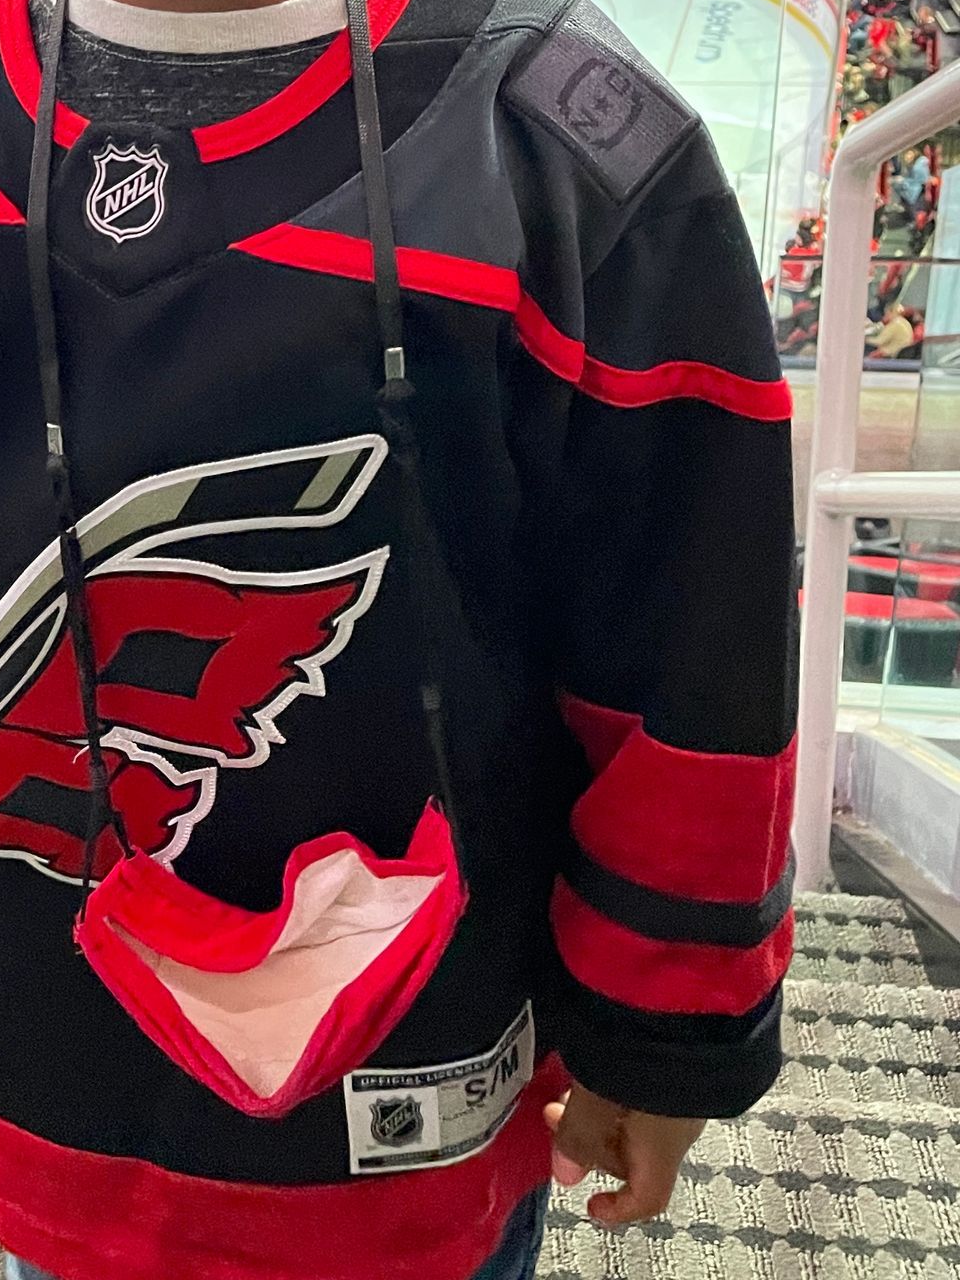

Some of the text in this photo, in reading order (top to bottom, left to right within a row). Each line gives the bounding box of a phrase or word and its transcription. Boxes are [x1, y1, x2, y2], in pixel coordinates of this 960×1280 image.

[103, 172, 154, 220] NHL
[359, 1073, 422, 1087] OFFICIAL
[464, 1042, 520, 1108] S/M
